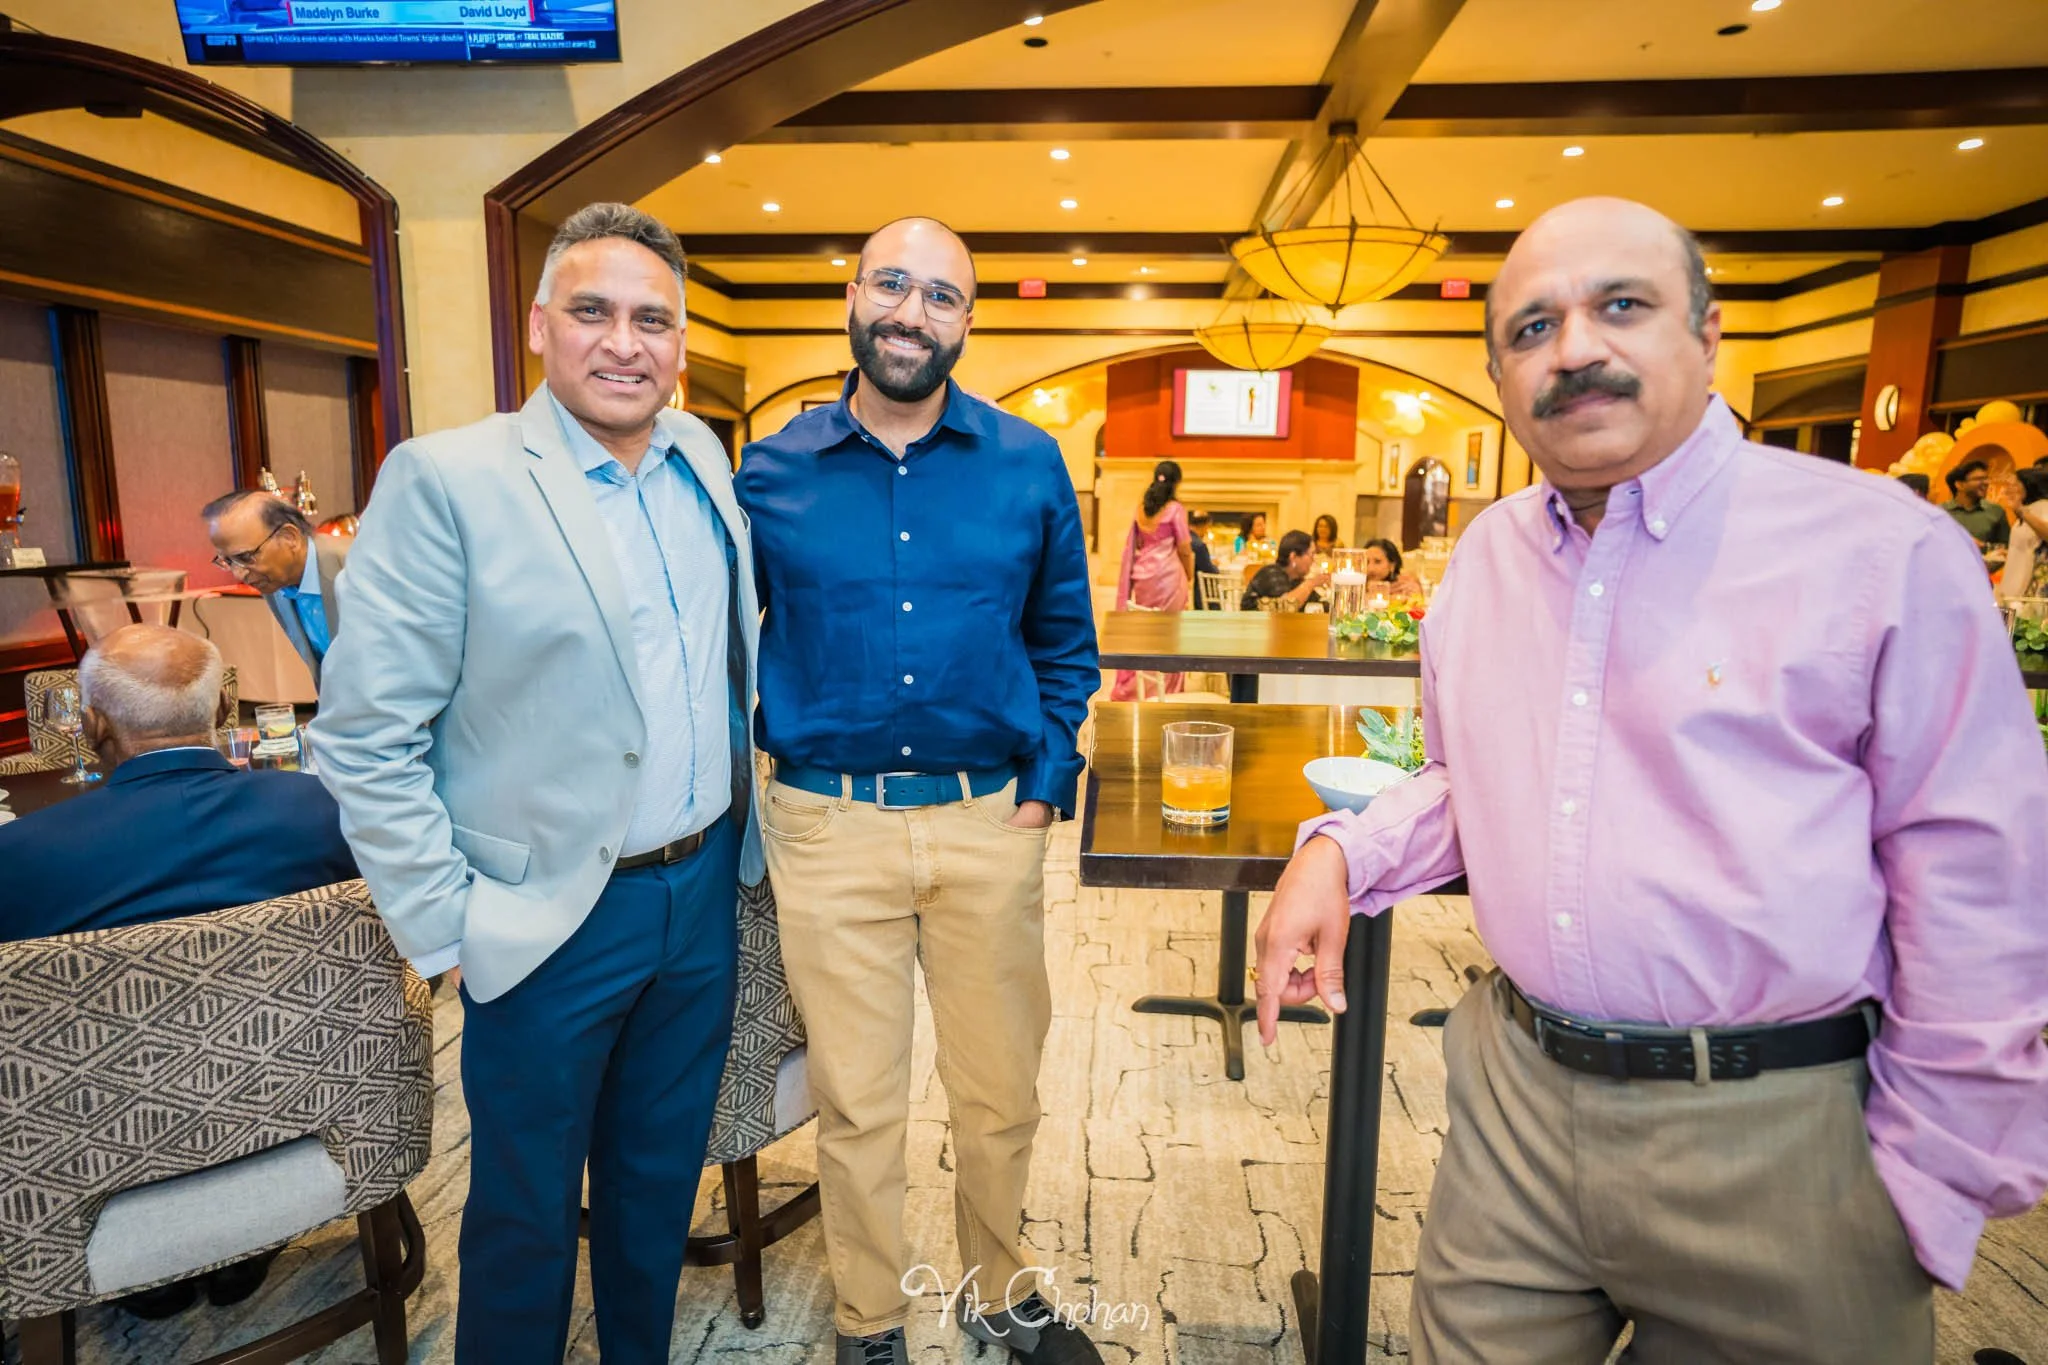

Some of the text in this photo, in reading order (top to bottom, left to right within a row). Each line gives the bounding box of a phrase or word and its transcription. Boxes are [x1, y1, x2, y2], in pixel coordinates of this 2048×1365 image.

[295, 6, 380, 21] Madelyn Burke
[459, 5, 527, 19] David Lloyd
[524, 32, 540, 41] TRAIL
[540, 32, 565, 41] BLAZERS
